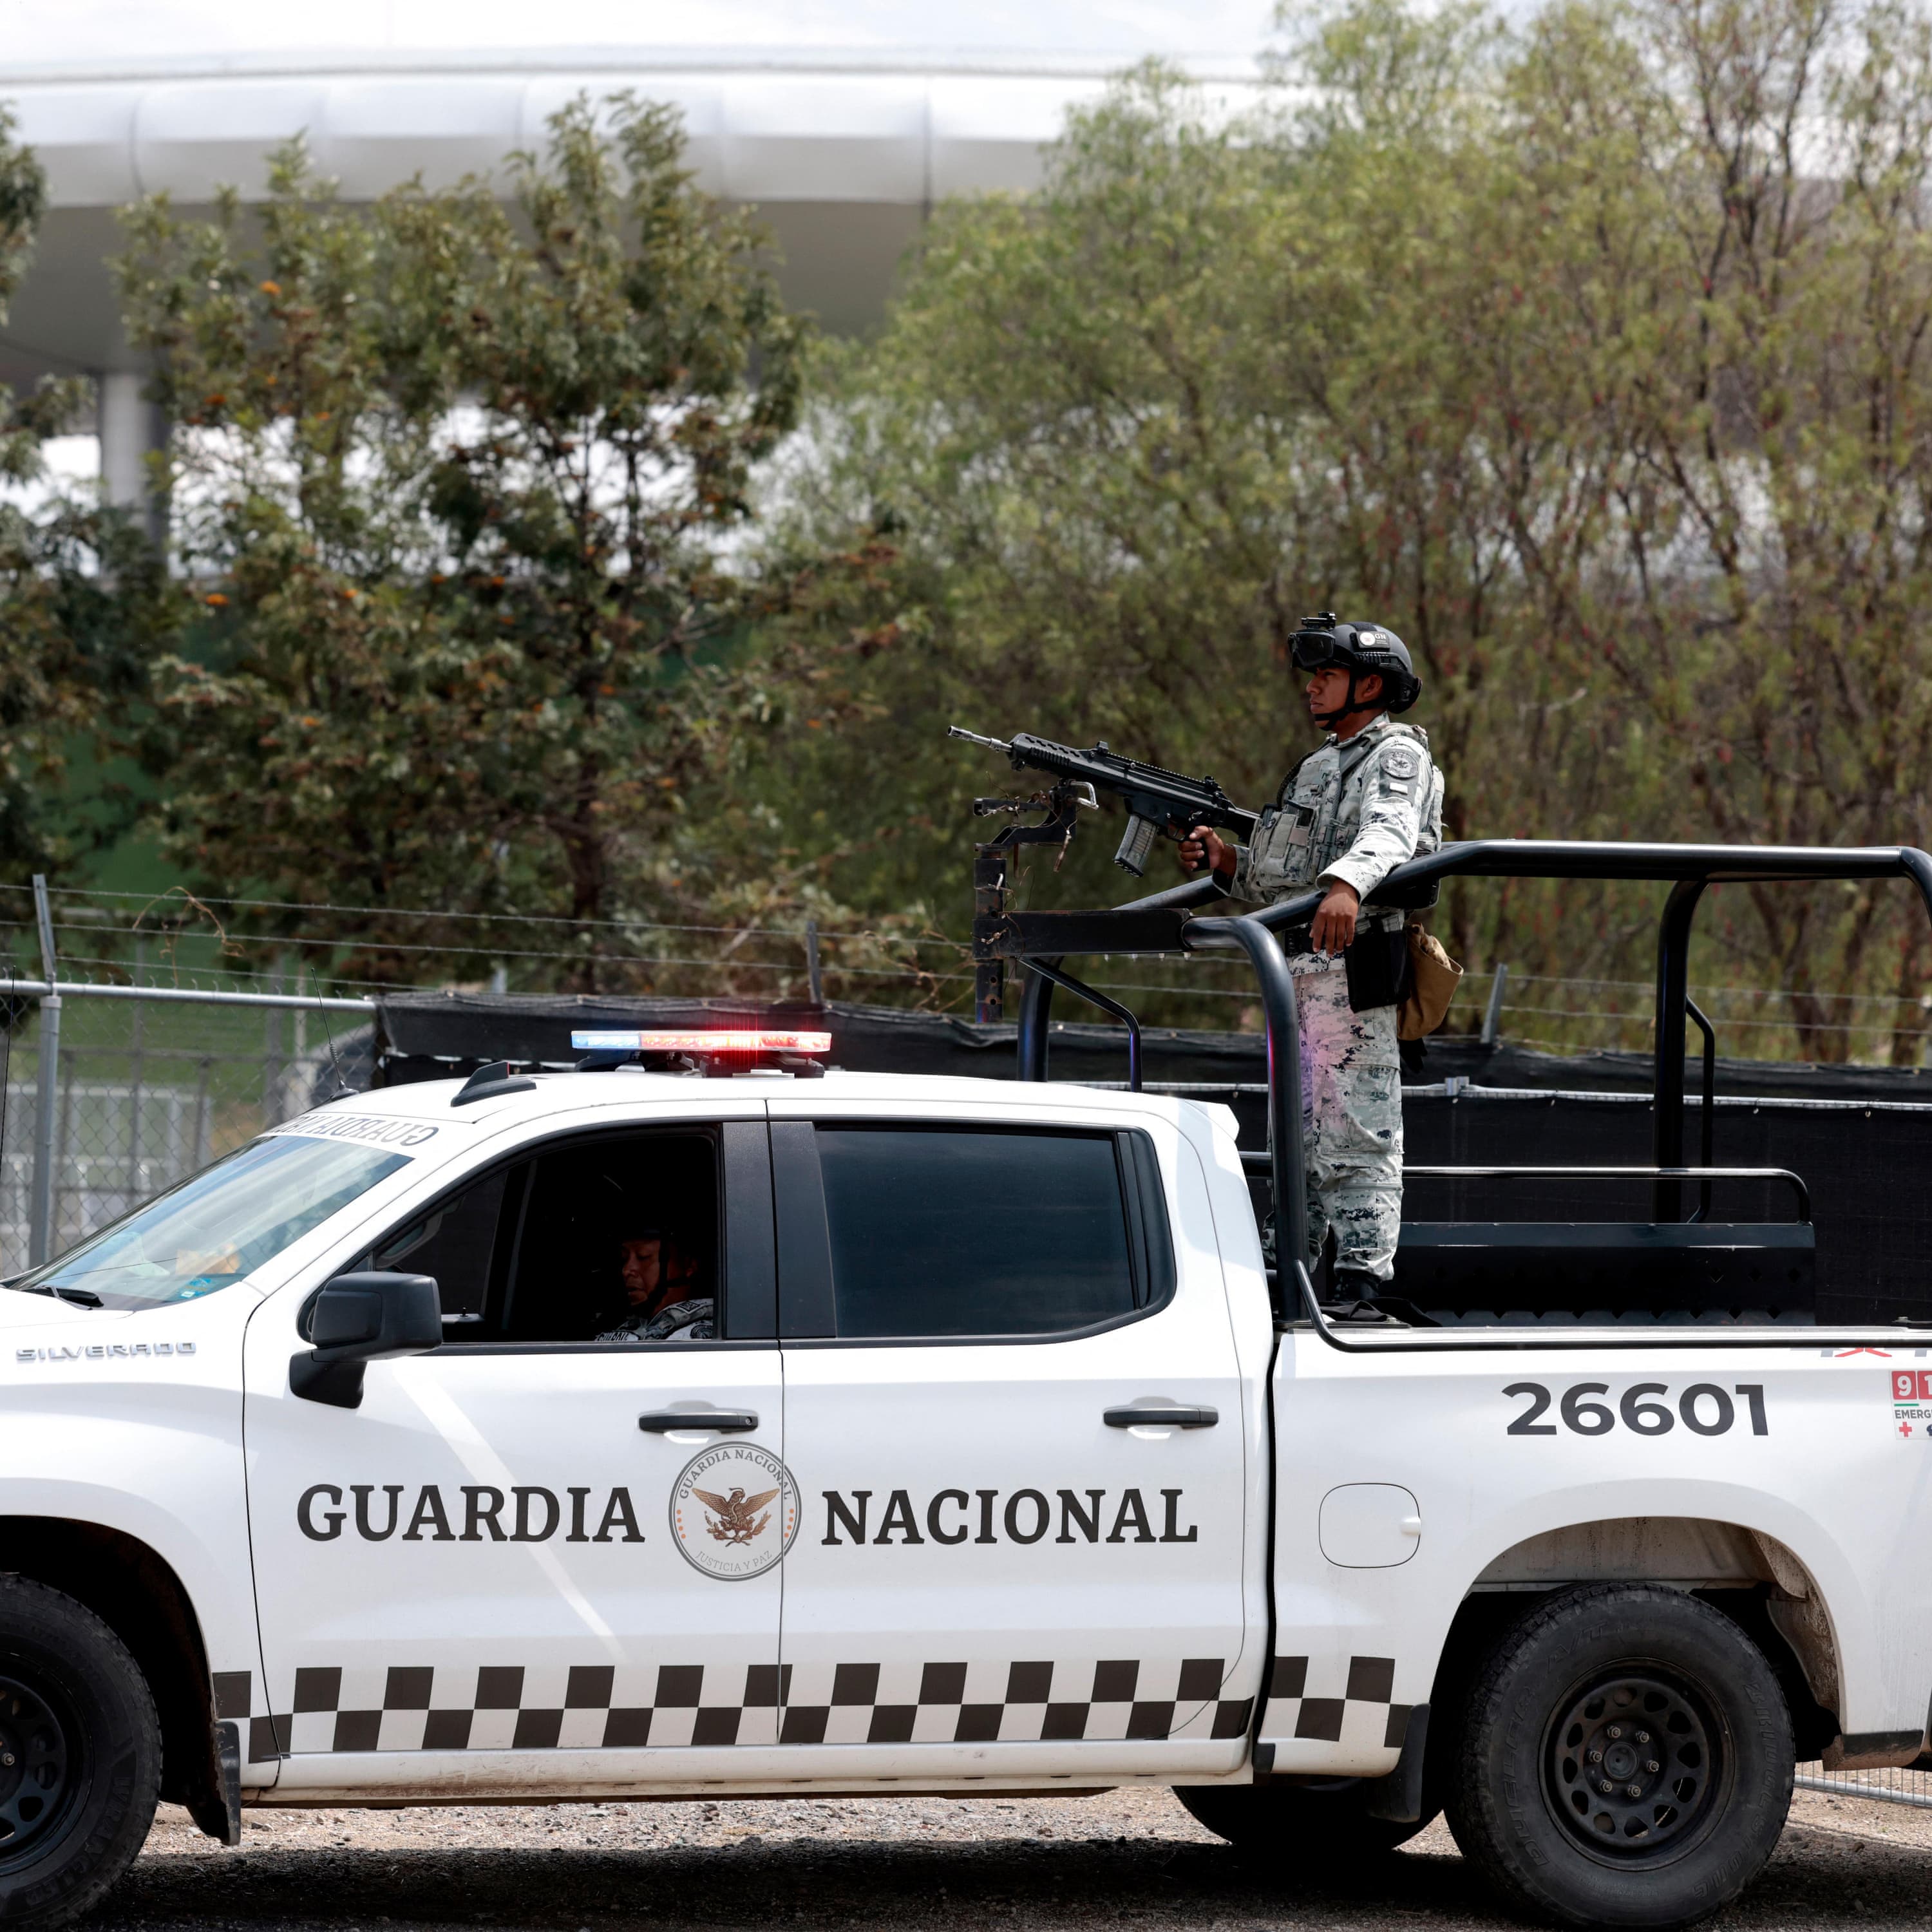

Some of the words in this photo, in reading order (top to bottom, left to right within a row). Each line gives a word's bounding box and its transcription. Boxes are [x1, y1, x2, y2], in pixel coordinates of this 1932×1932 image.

[16, 1343, 196, 1360] SILVERADO
[1501, 1382, 1768, 1436] 26601
[1895, 1409, 1932, 1419] EMERG
[679, 1450, 730, 1499] GUARDIA
[735, 1450, 792, 1500] NACIONAL
[297, 1484, 645, 1542] GUARDIA
[821, 1488, 1198, 1546] NACIONAL
[695, 1551, 741, 1572] JUSTICIA
[743, 1561, 750, 1570] Y
[753, 1550, 773, 1567] PAZ
